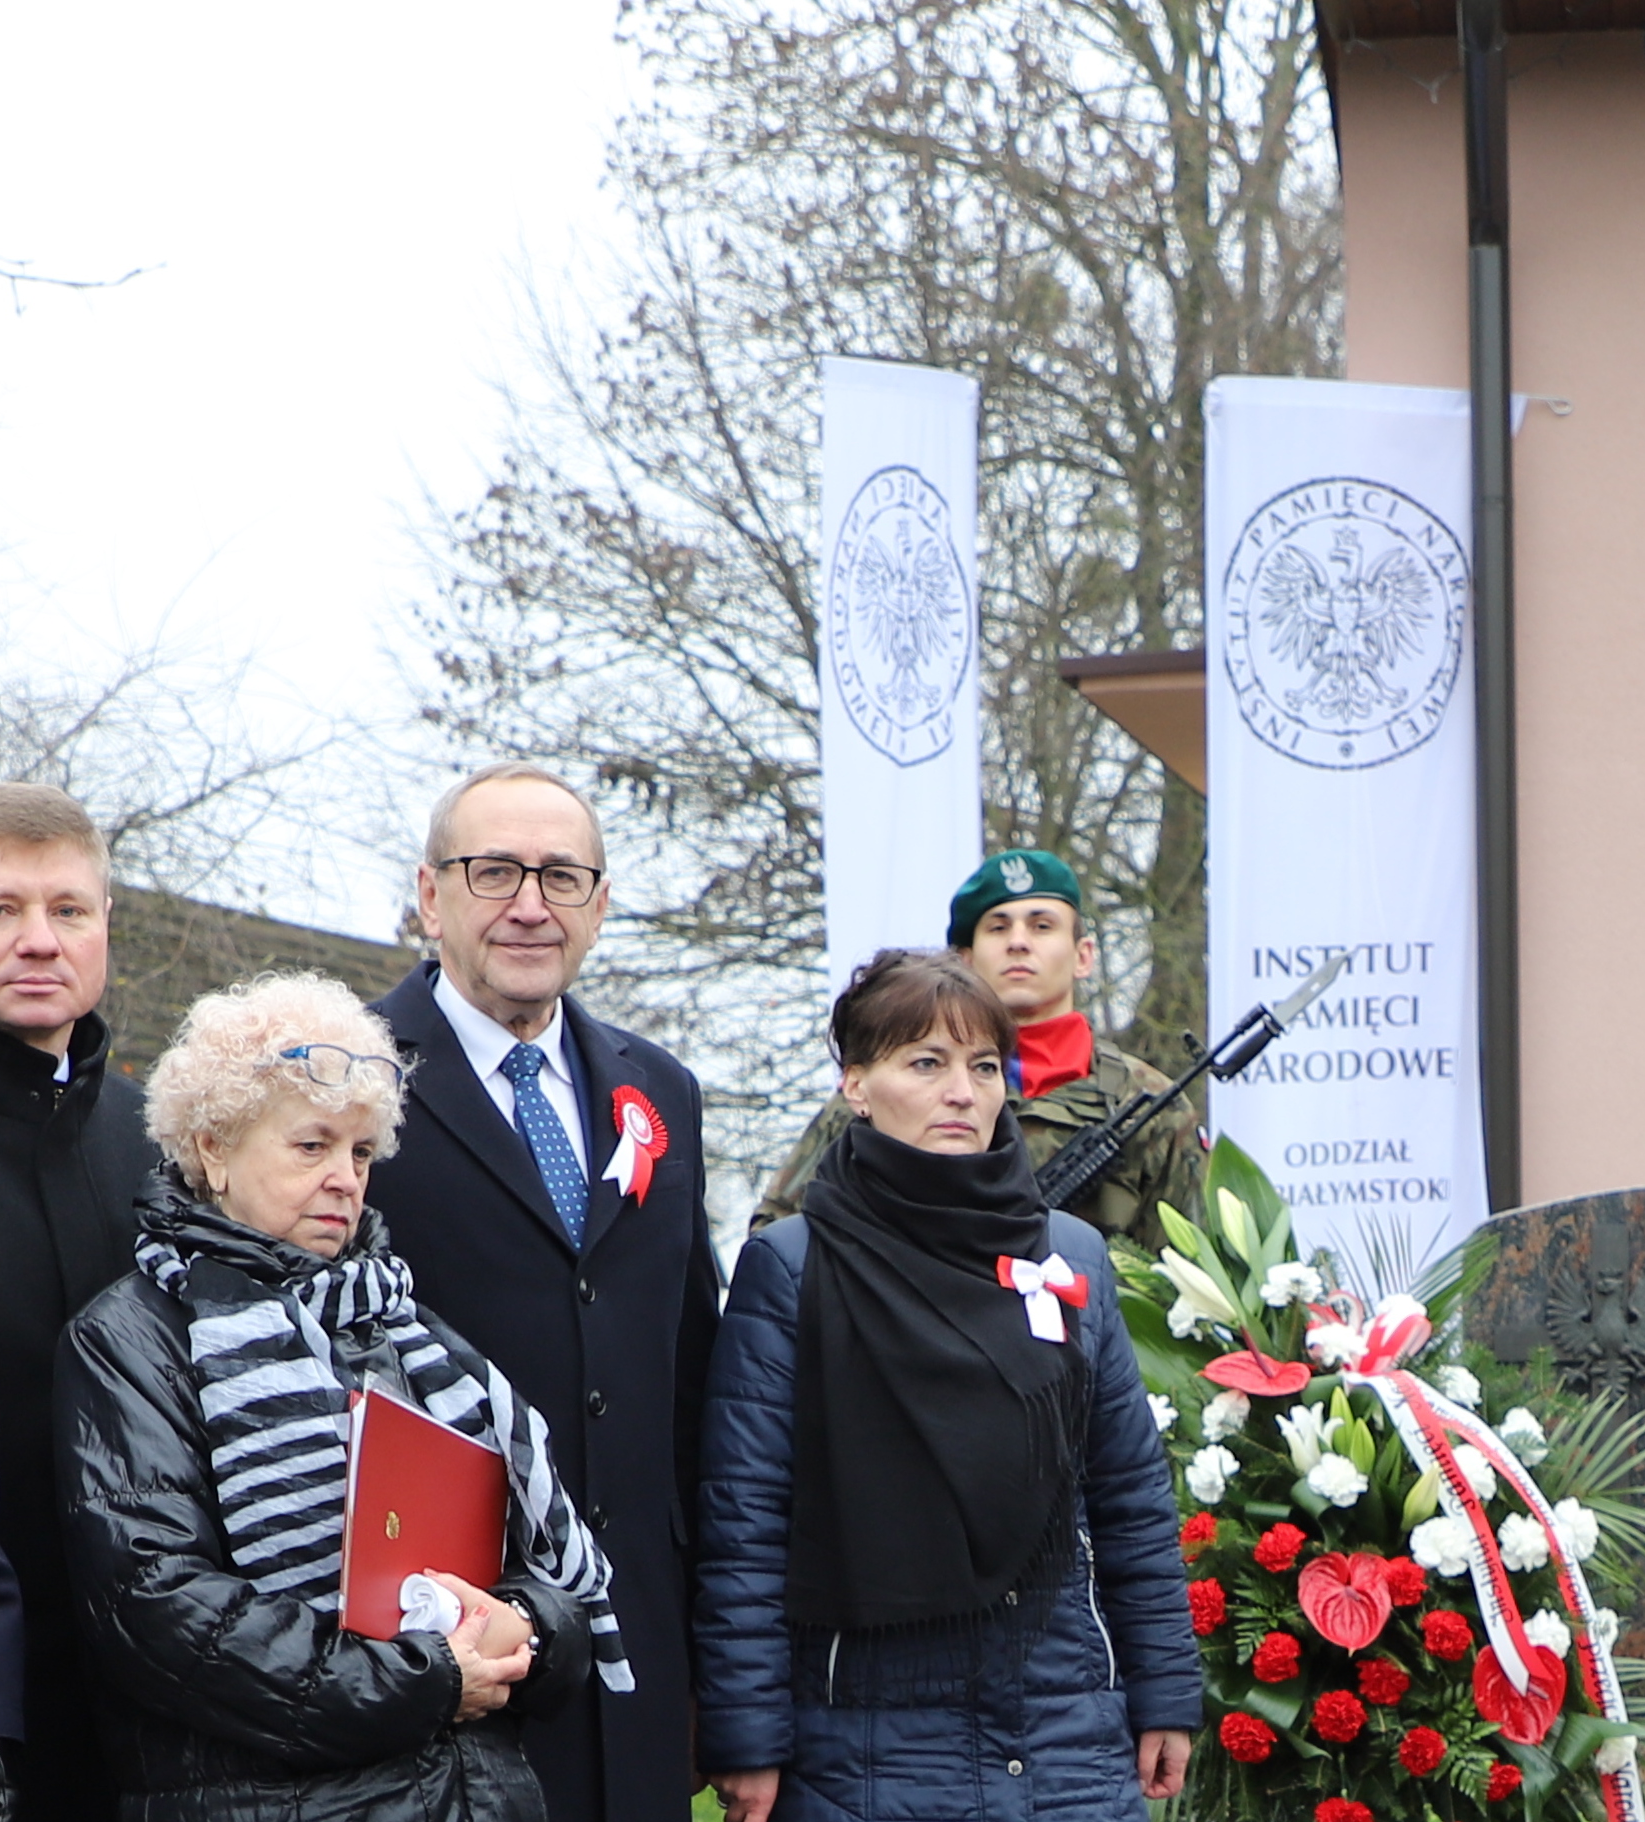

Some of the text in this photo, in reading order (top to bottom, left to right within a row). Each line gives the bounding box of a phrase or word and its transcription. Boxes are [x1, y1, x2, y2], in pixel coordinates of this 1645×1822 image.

[1248, 486, 1399, 549] PAMIĘCI
[1252, 942, 1435, 978] INSTYTUT
[1272, 995, 1420, 1036] AMIĘCI
[1234, 1047, 1459, 1086] ARODOWE
[1283, 1138, 1414, 1168] ODDZIAŁ
